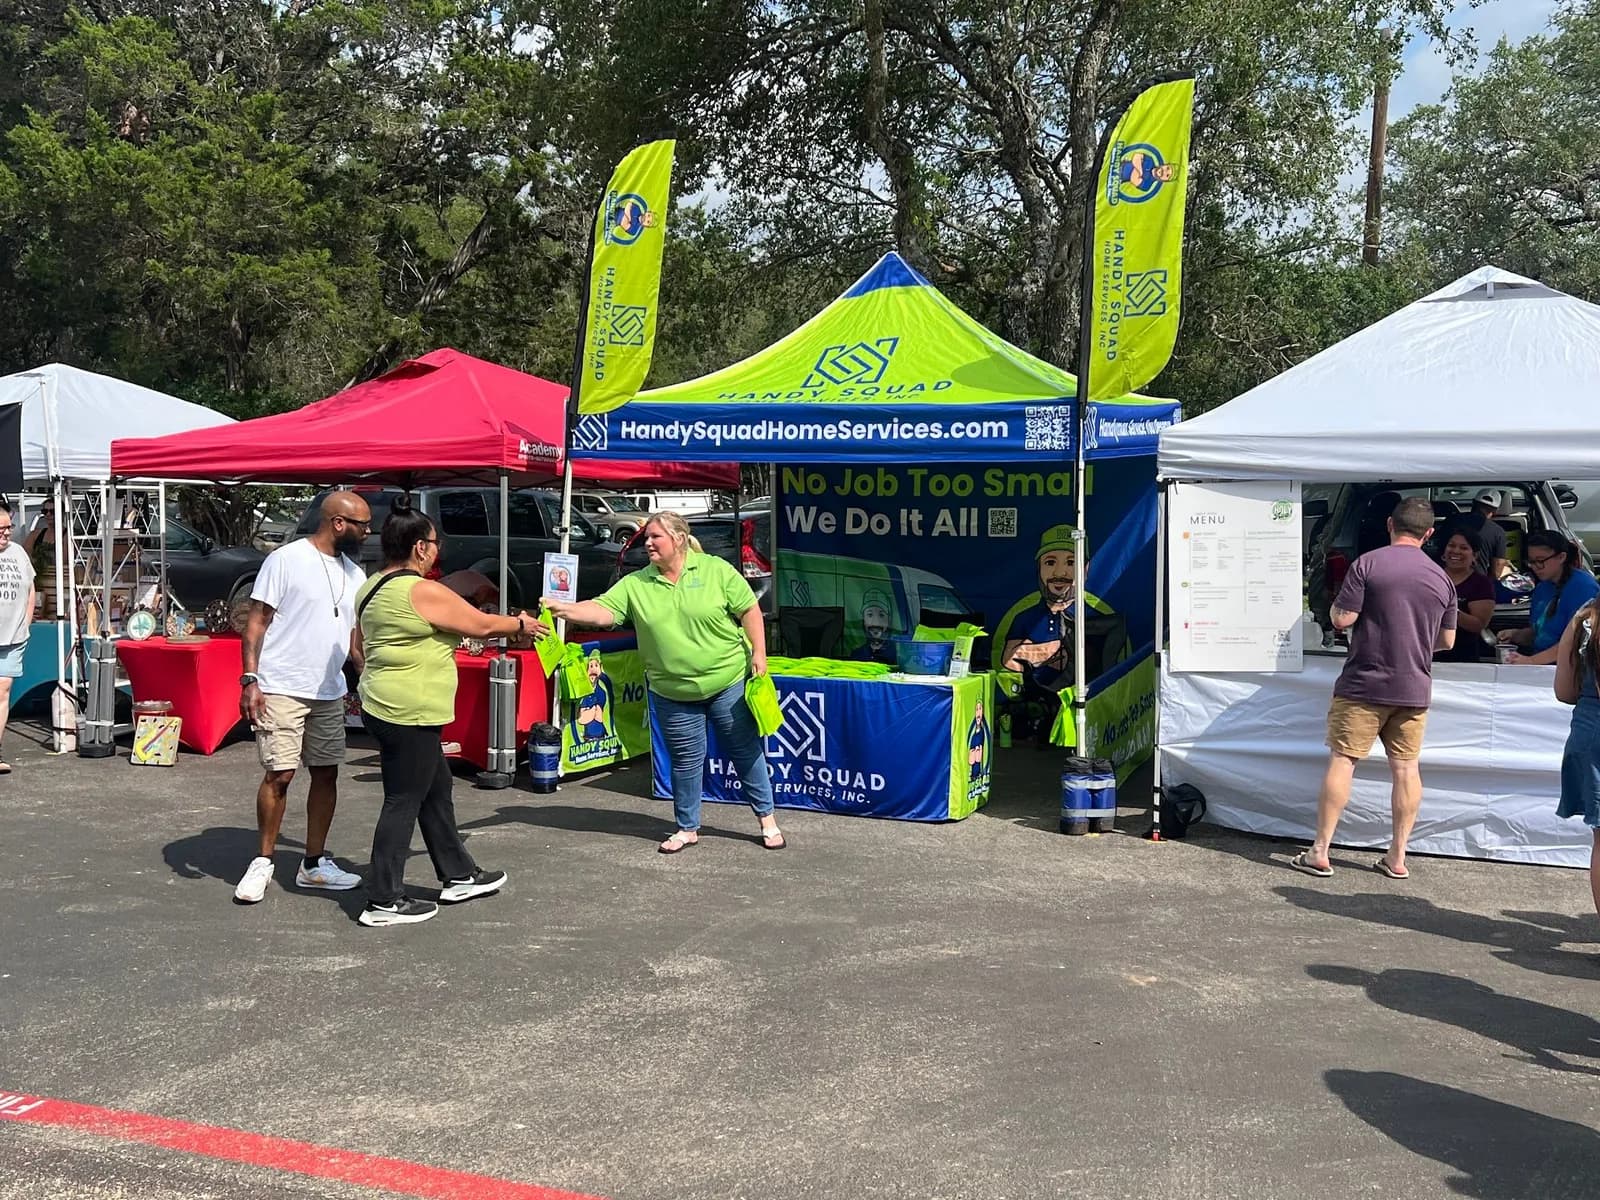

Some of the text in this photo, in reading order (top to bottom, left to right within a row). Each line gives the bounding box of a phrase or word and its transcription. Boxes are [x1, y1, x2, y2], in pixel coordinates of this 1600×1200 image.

[1103, 240, 1111, 268] HOME
[1106, 231, 1125, 361] HANDY SQUAD
[595, 267, 615, 381] HANDY SQUAD
[717, 380, 953, 400] HANDY SQUAD
[621, 418, 1009, 446] HandySquadHomeServices.com
[519, 439, 563, 462] Academy
[782, 464, 1094, 497] No Job Too Smal
[785, 505, 978, 537] We Do It All
[1190, 515, 1225, 525] MENU
[622, 682, 644, 703] No
[570, 741, 597, 758] HANDY
[803, 765, 886, 791] SQUAD
[774, 783, 837, 801] ERVICES,
[842, 790, 871, 804] INC.
